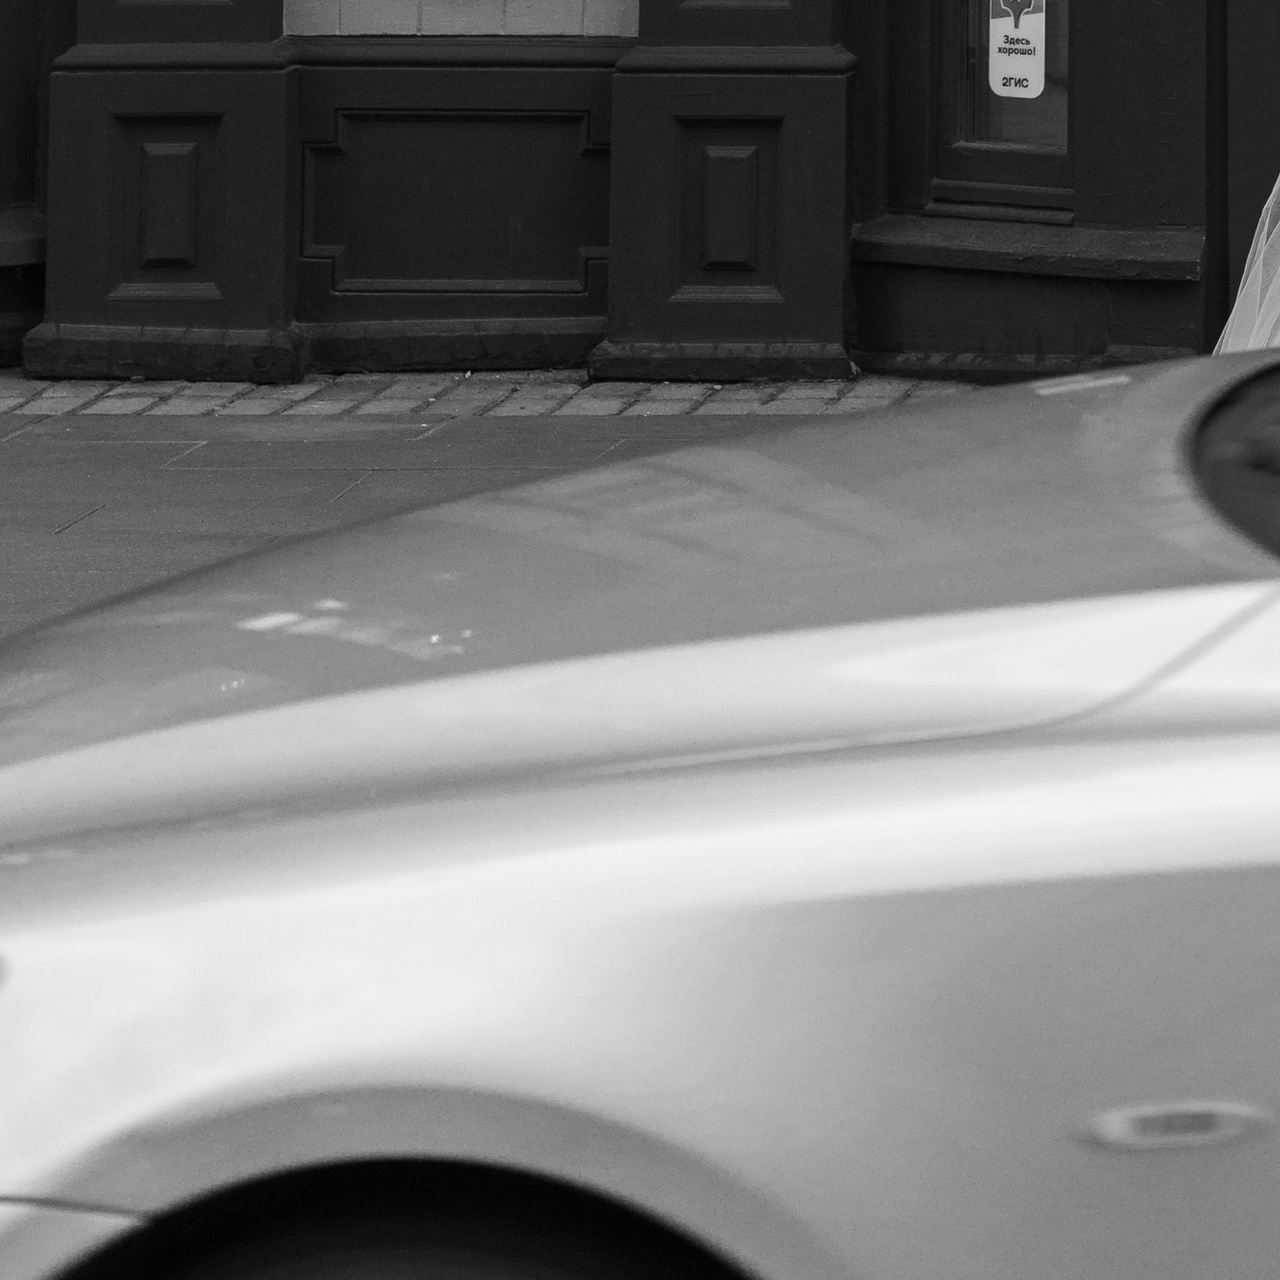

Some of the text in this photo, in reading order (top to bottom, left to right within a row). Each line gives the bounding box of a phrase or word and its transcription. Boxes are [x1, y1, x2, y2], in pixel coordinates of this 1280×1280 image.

[1003, 35, 1031, 46] Здесь
[997, 46, 1036, 56] хорошо!
[1001, 76, 1030, 89] 2ГИС
